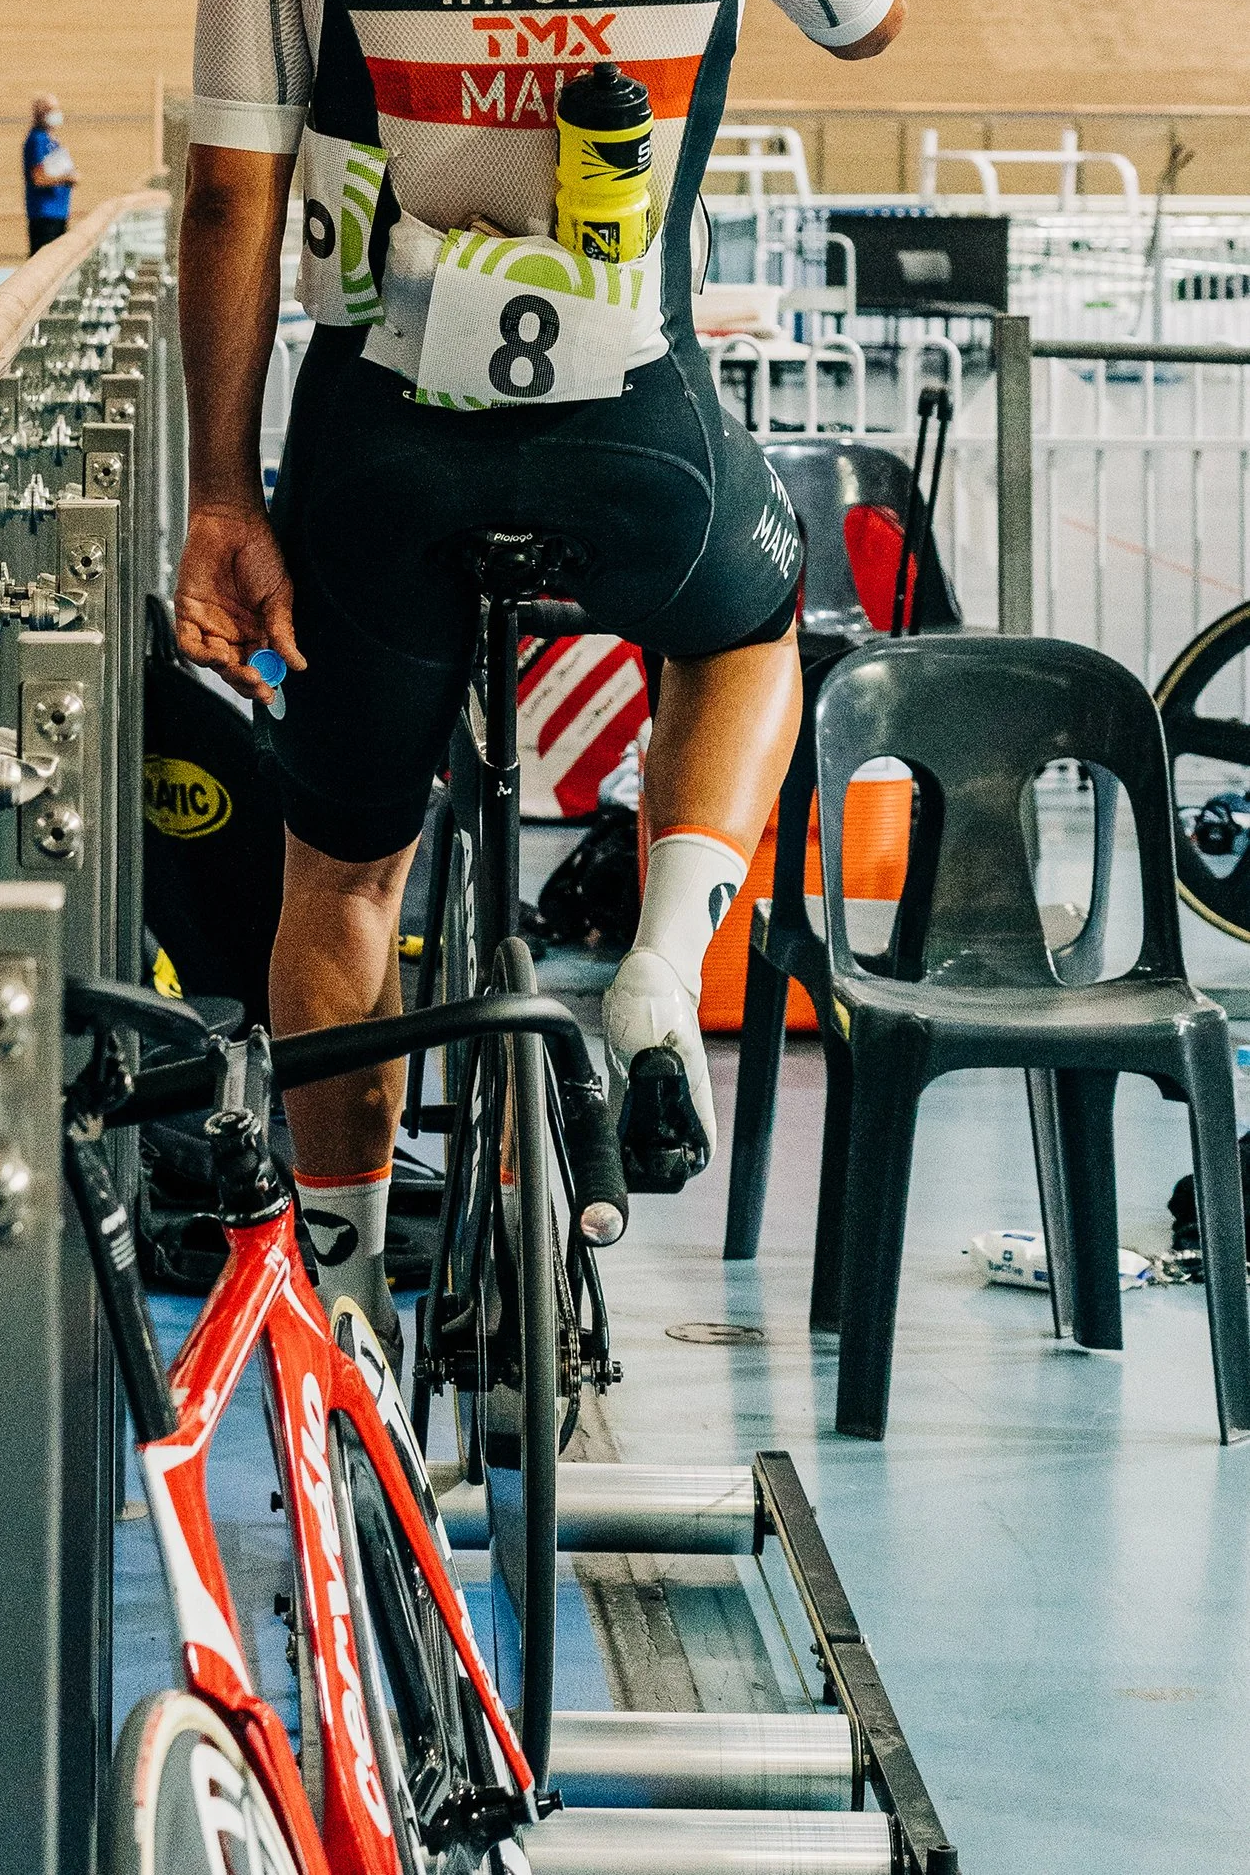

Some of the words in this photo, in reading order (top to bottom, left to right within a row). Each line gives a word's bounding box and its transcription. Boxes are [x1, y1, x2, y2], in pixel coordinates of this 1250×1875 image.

[472, 13, 617, 58] TMX
[460, 69, 589, 122] MA
[488, 293, 561, 399] 8
[752, 504, 799, 580] MAKE
[144, 778, 210, 816] AVIC
